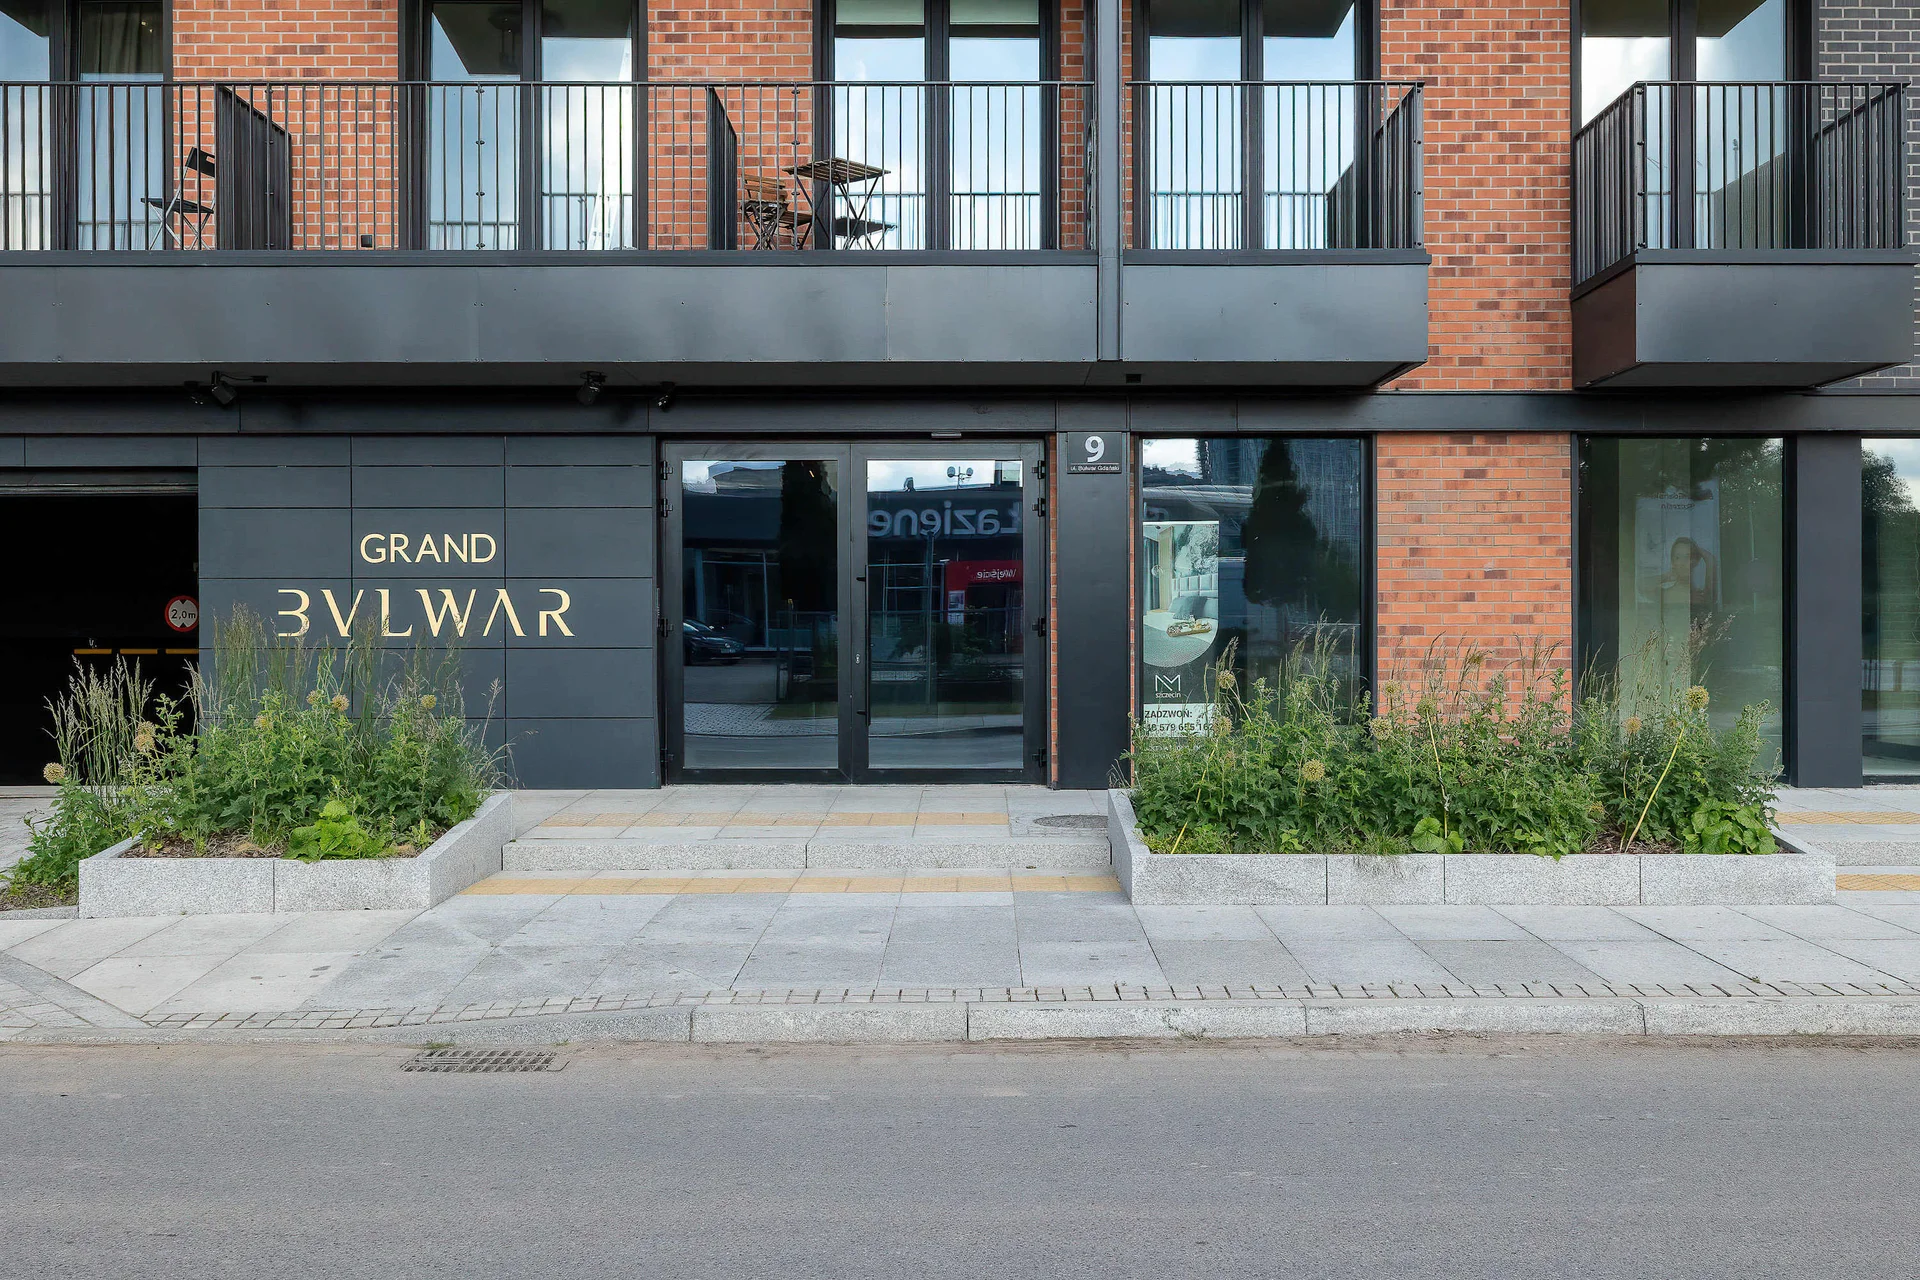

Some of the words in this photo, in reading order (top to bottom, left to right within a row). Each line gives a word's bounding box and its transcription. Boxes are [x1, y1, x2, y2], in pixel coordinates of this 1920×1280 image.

[1084, 435, 1105, 463] 9
[359, 532, 497, 564] GRAND
[1159, 723, 1176, 731] 579
